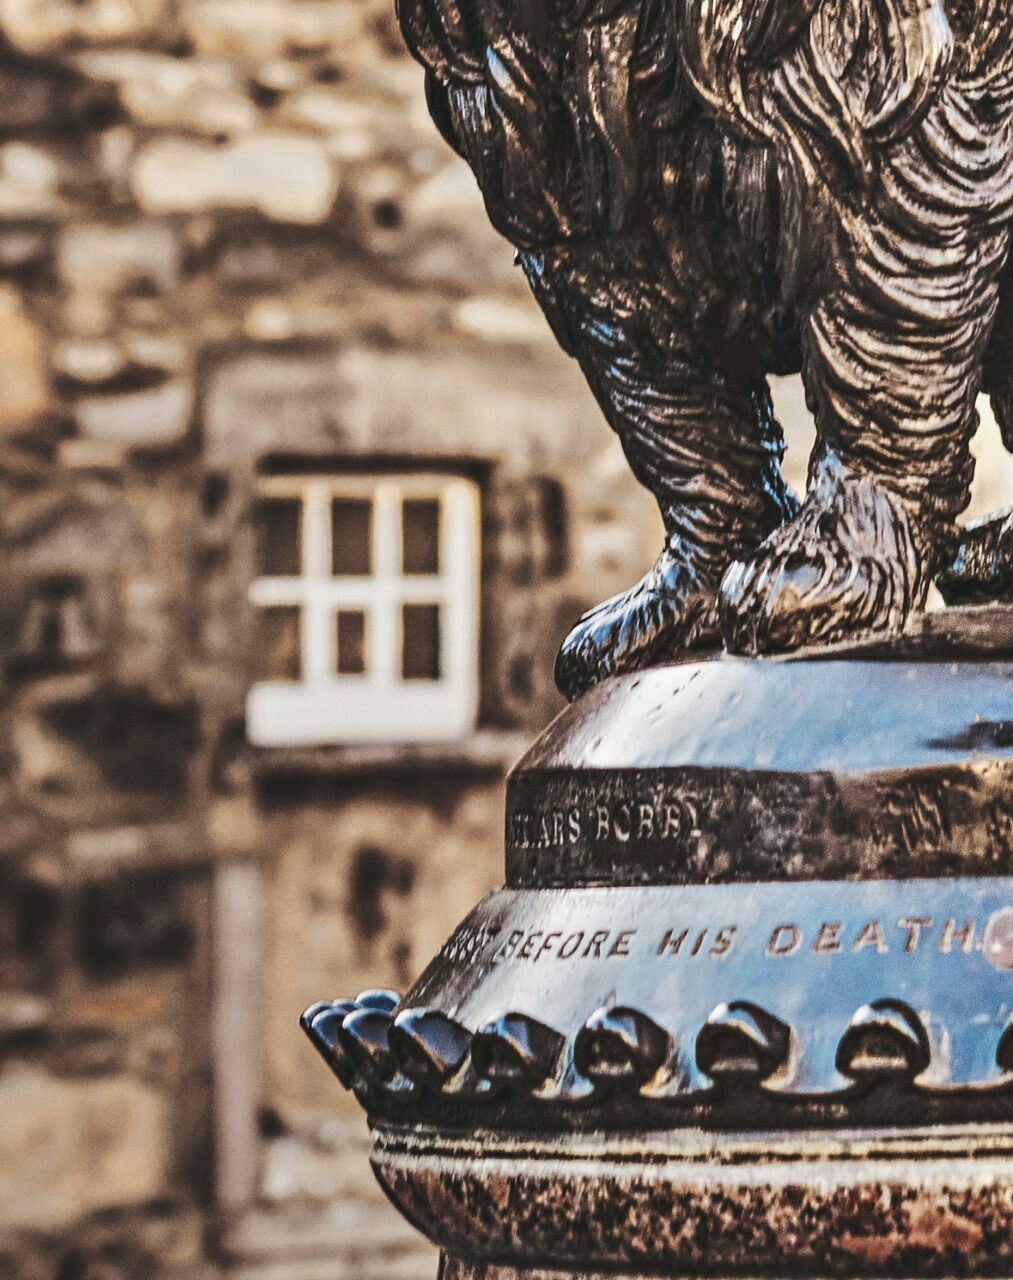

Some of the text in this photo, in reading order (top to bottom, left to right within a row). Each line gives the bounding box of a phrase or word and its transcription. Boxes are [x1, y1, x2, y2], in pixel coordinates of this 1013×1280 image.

[594, 798, 703, 843] BOBBY
[499, 928, 637, 962] BEFORE
[656, 926, 738, 958] HIS
